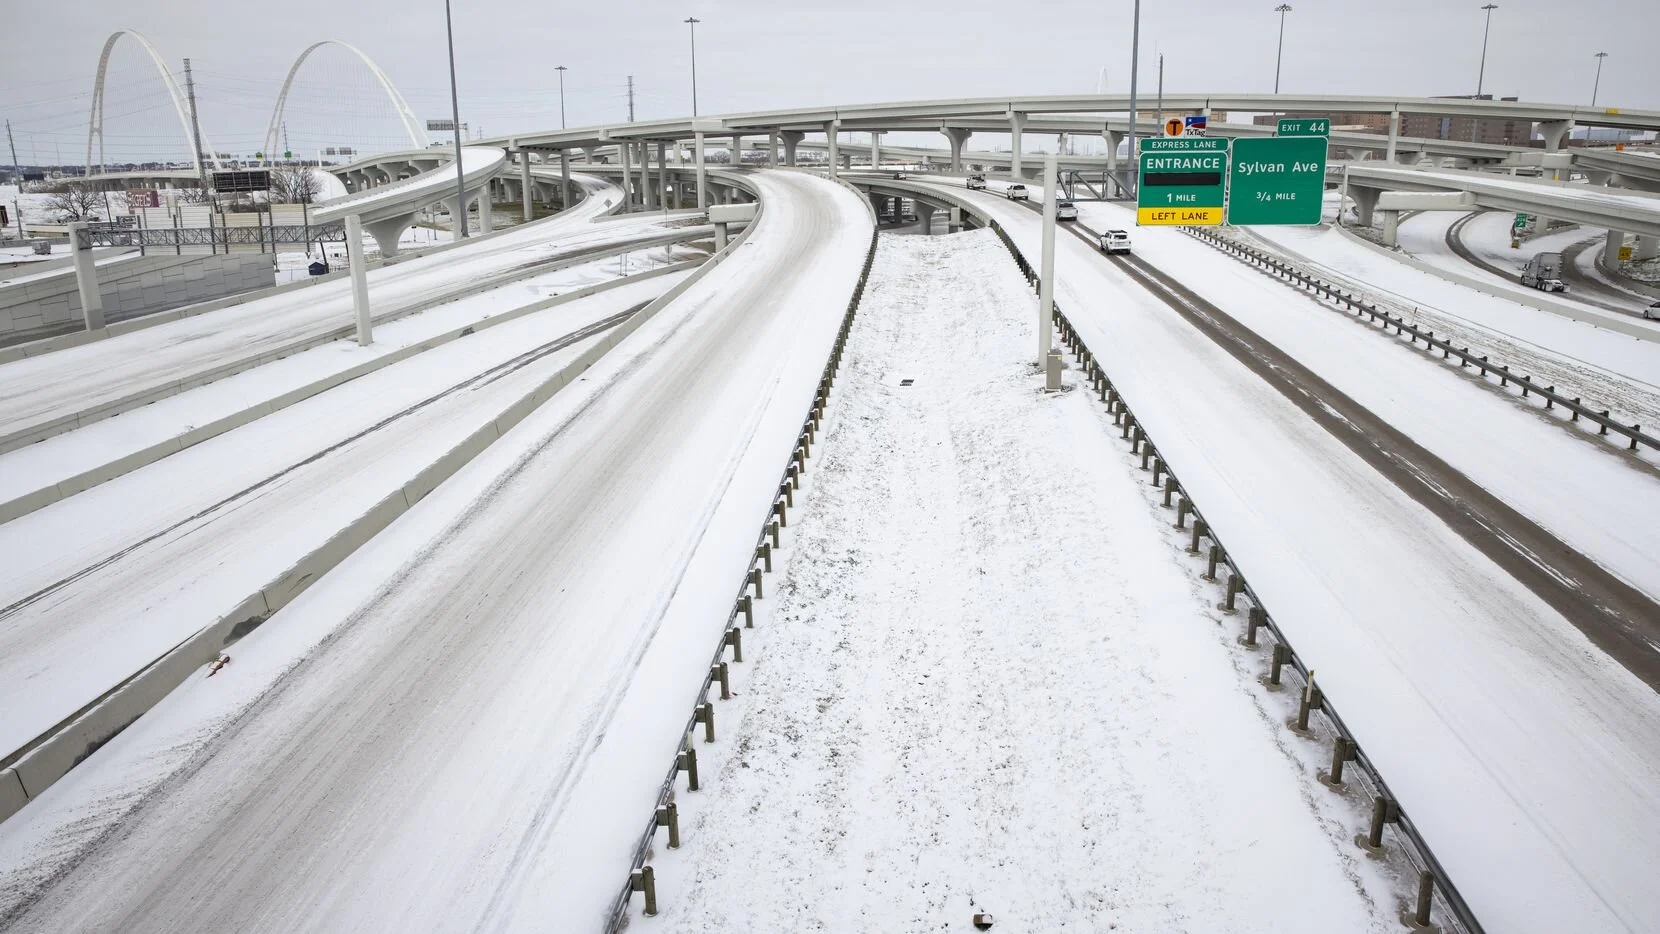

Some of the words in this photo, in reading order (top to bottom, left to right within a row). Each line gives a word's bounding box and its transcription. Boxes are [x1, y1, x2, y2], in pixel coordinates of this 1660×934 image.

[1169, 120, 1181, 136] T
[1281, 124, 1301, 132] EXIT
[1309, 122, 1325, 132] 44
[1185, 128, 1206, 137] TxTag
[1151, 141, 1190, 149] EXPRESS
[1146, 158, 1220, 169] ENTRANCE
[1238, 161, 1285, 175] Sylvan
[1292, 161, 1318, 172] Ave
[1167, 193, 1172, 203] 1
[1176, 194, 1196, 202] MILE
[1256, 191, 1271, 202] 3/4
[1275, 192, 1296, 200] MILE
[1151, 212, 1176, 220] LEFT
[1181, 212, 1208, 220] LANE
